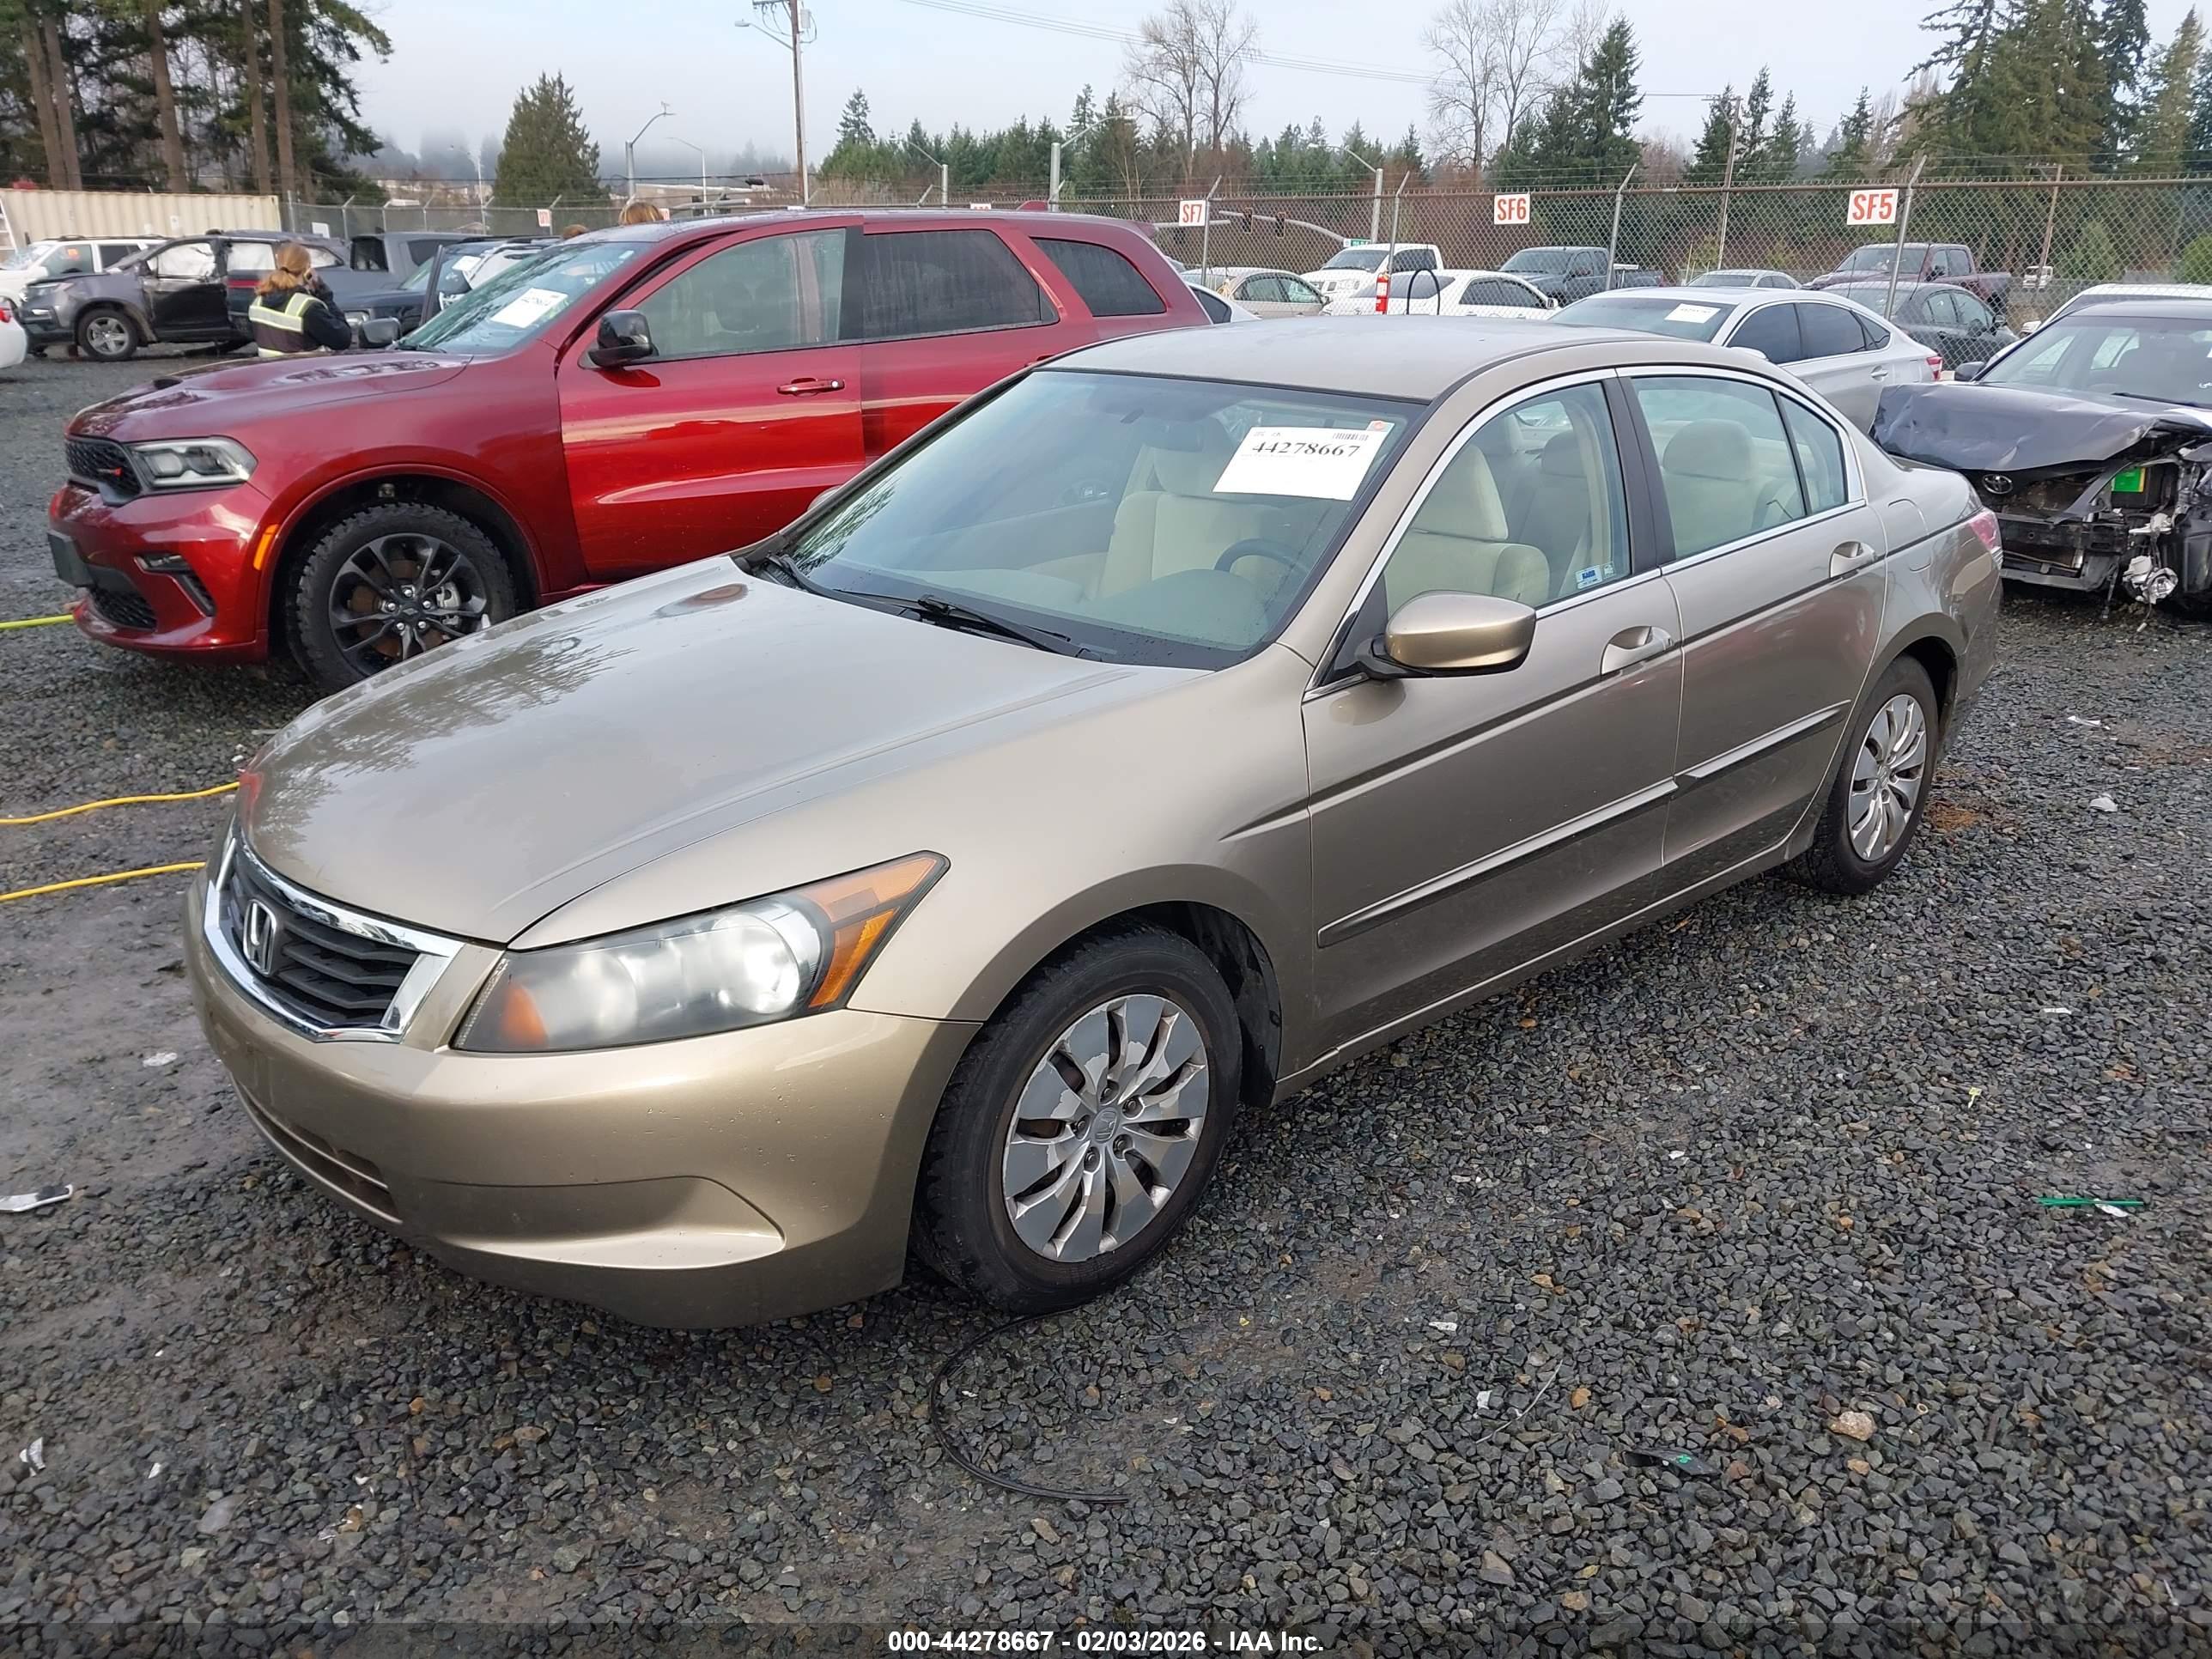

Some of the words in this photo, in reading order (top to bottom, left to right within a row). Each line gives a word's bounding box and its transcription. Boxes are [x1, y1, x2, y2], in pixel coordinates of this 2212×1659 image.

[1182, 204, 1202, 223] SF7
[1497, 198, 1527, 221] SF6
[1852, 193, 1893, 220] SF5
[1252, 441, 1361, 457] 44278667
